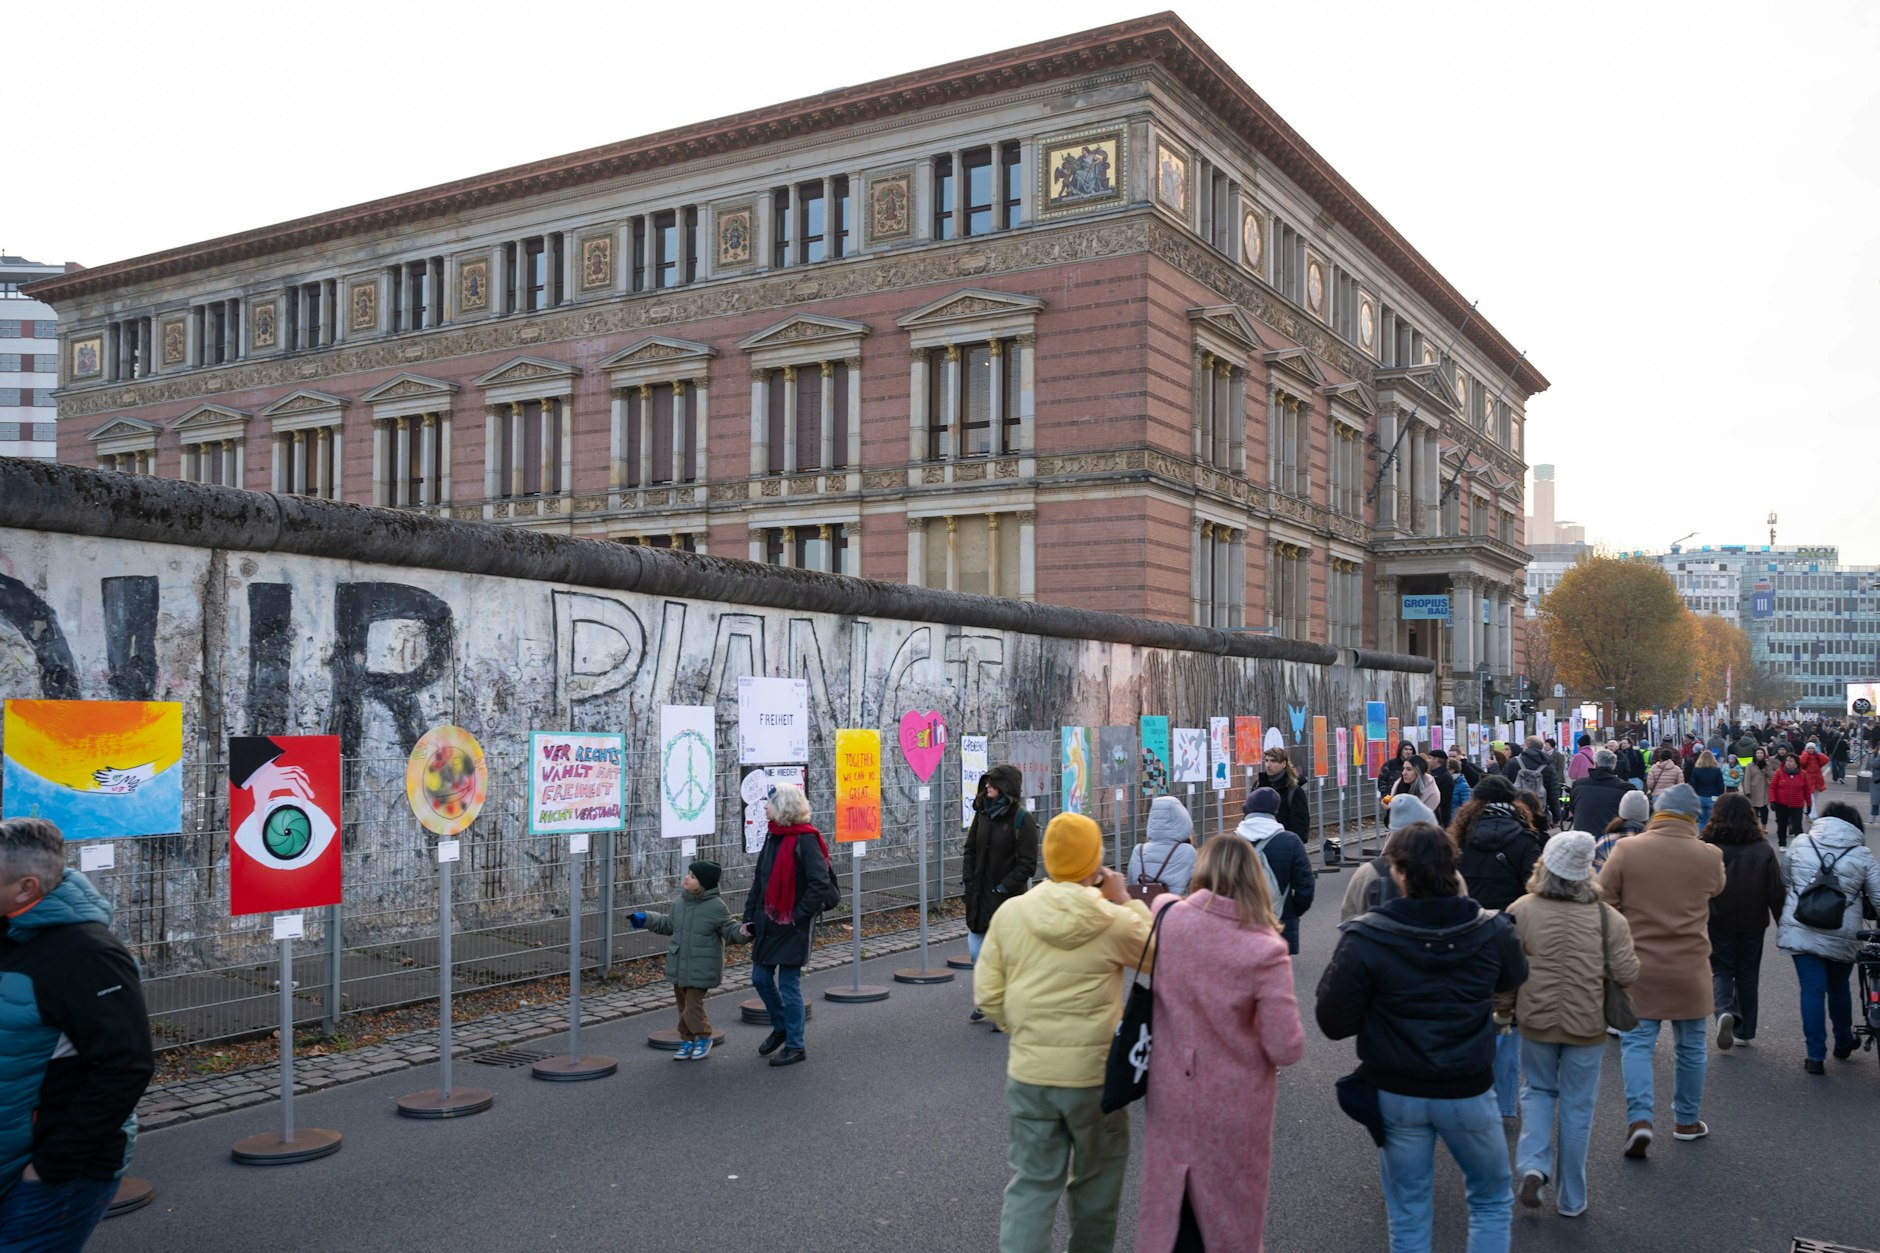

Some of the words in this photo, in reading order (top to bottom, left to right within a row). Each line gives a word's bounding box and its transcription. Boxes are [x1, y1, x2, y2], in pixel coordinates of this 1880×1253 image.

[1797, 548, 1835, 558] DKV
[1404, 599, 1448, 608] GROPIUS
[760, 713, 794, 726] FREIHEIT
[905, 719, 945, 752] Berlin
[575, 746, 622, 765] RECHTS
[845, 753, 875, 768] TOGETHER
[542, 763, 593, 782] WÄHLT
[765, 768, 775, 777] NIE
[777, 768, 798, 777] WIEDER
[843, 773, 852, 782] WE
[854, 771, 865, 781] CAN
[869, 771, 875, 780] DO
[542, 782, 614, 805] FREIHEIT
[849, 785, 869, 800] GREAT
[539, 808, 573, 823] NICHT
[846, 806, 877, 832] THINGS
